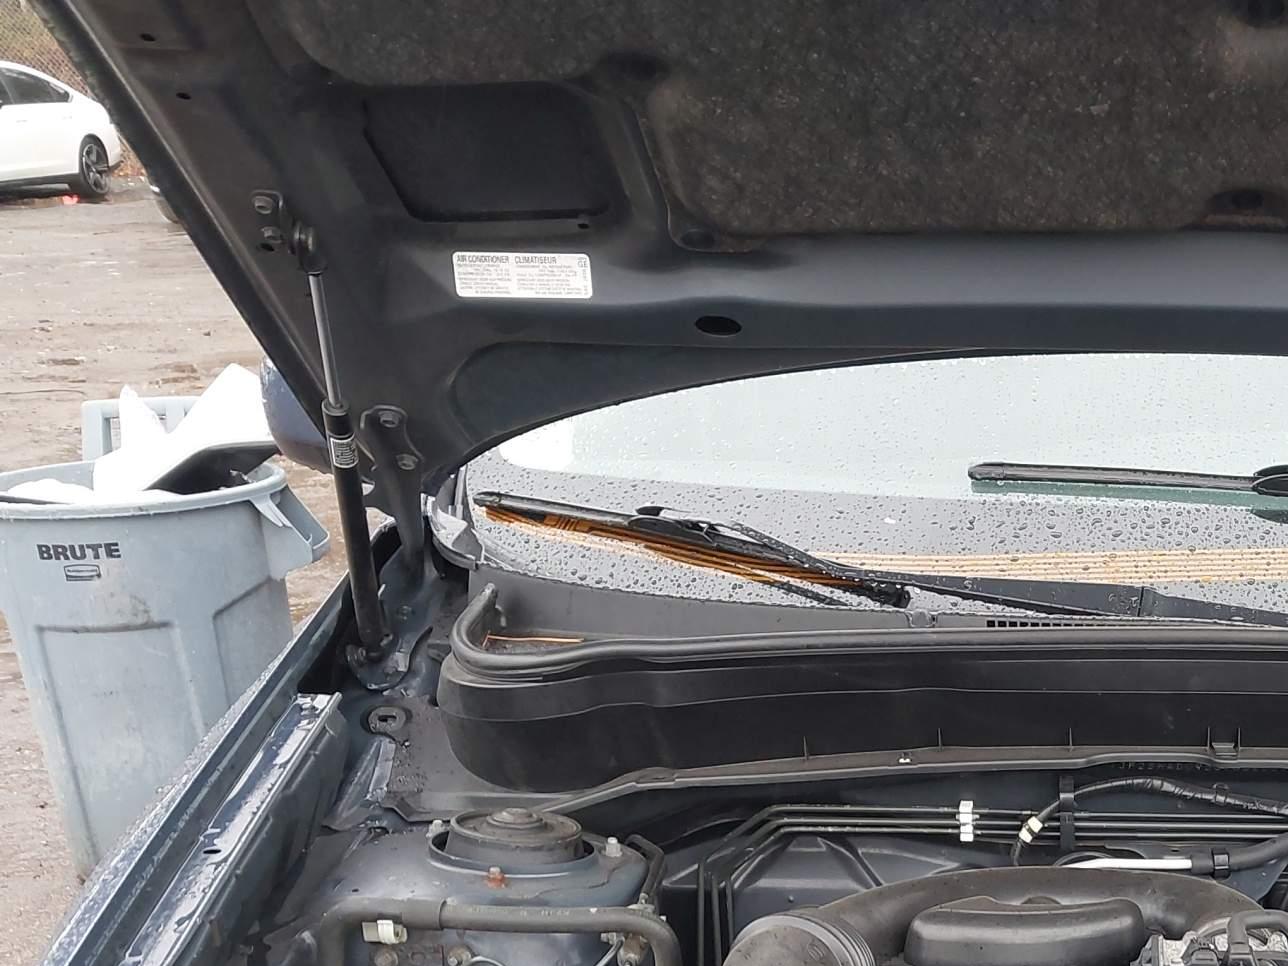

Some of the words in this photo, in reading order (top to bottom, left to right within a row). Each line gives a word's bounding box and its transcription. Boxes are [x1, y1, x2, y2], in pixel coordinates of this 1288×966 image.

[456, 254, 467, 263] AIR
[467, 255, 510, 264] CONDITIONER
[514, 255, 557, 265] CLIMATISEUR
[36, 542, 122, 561] BRUTE
